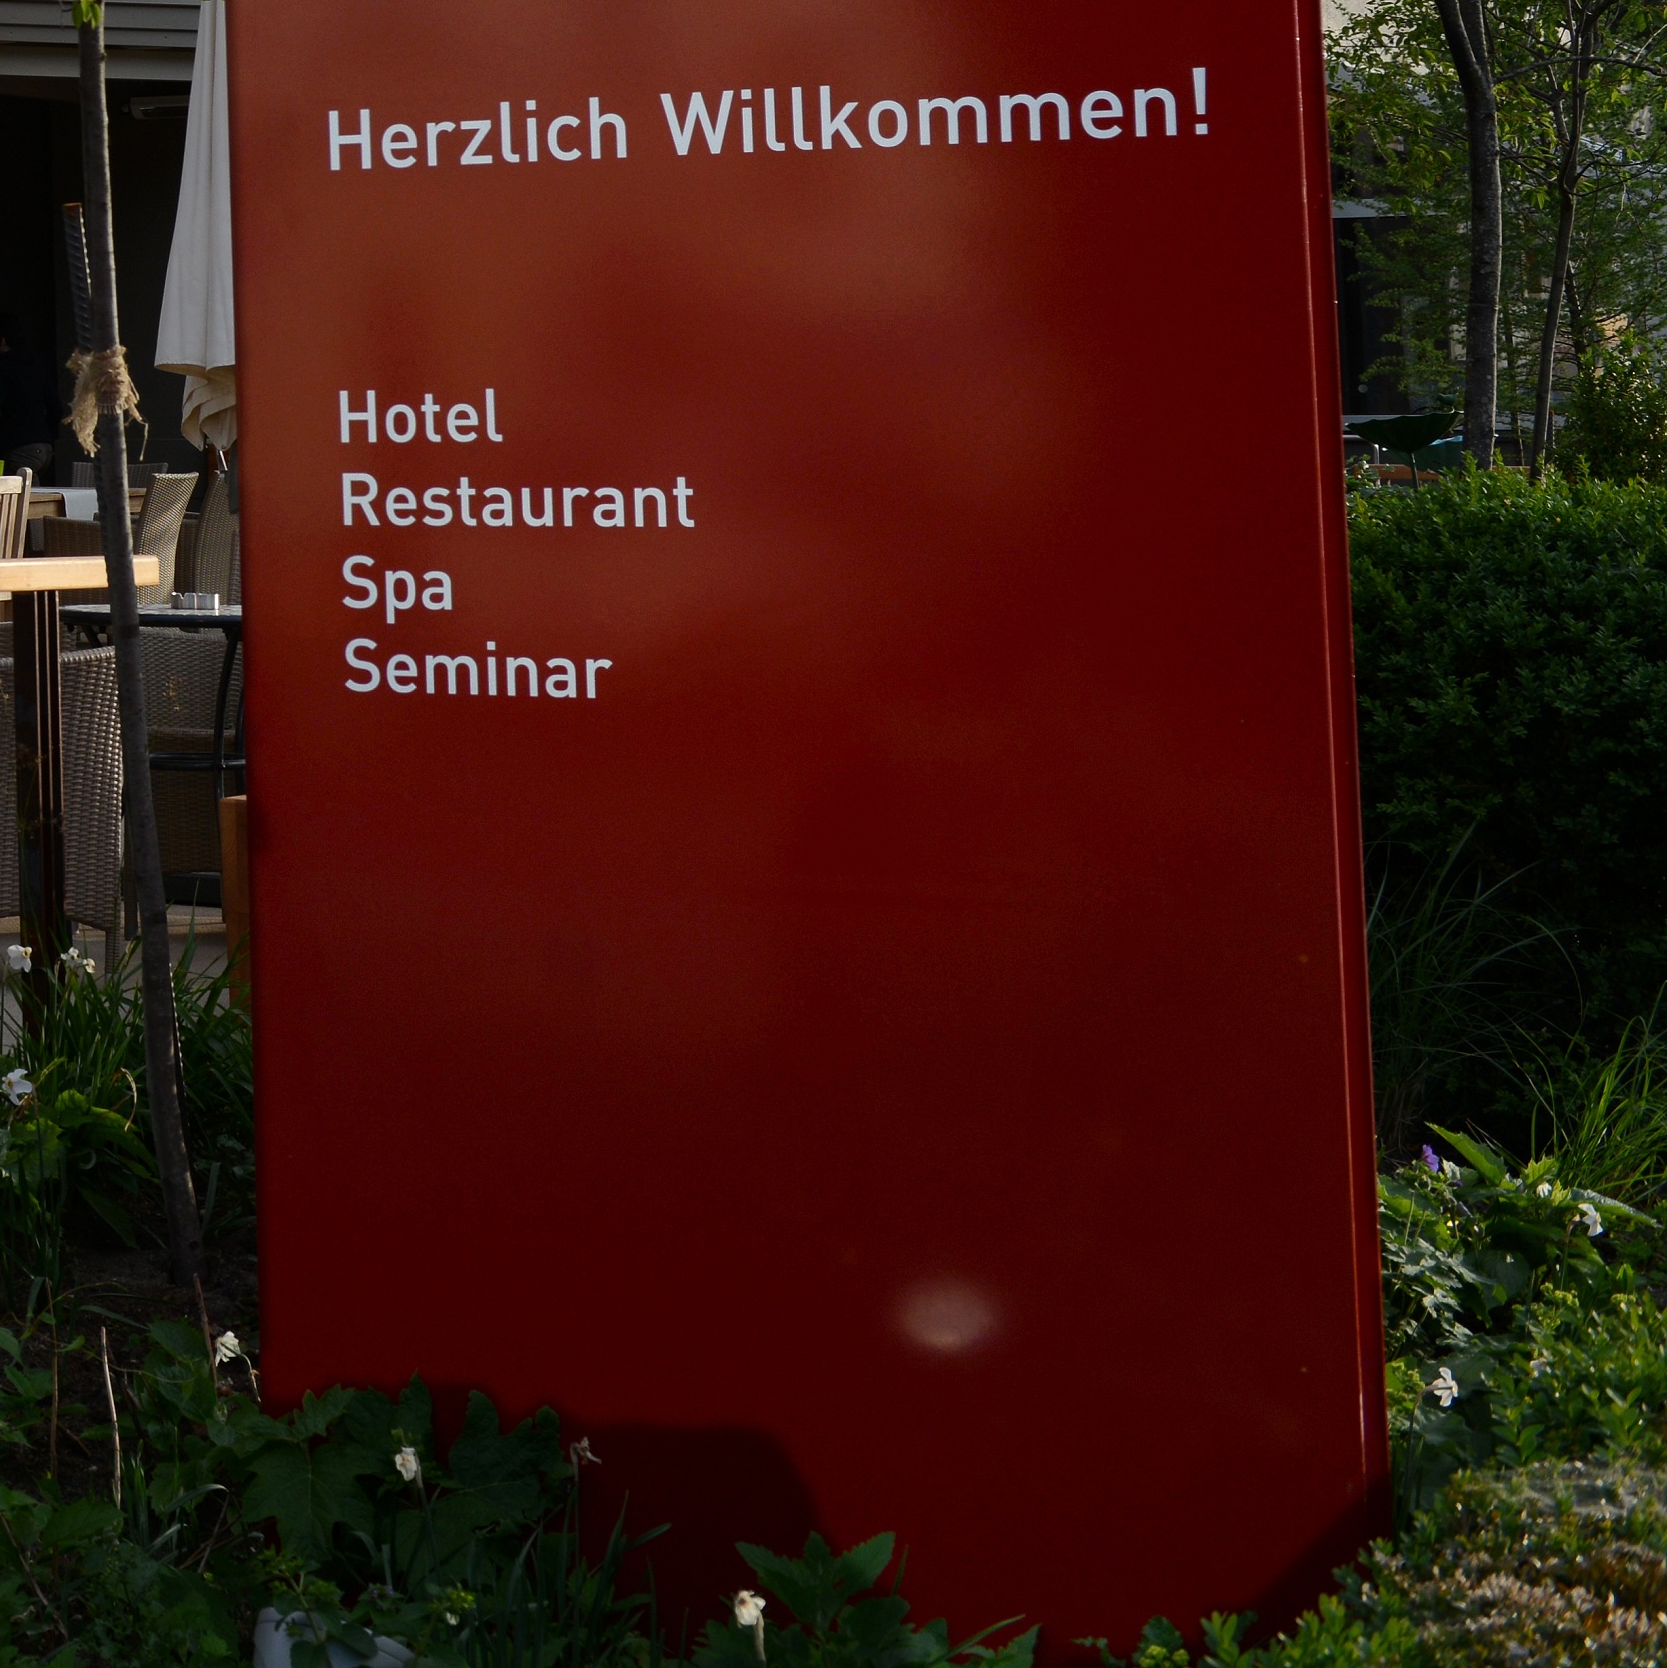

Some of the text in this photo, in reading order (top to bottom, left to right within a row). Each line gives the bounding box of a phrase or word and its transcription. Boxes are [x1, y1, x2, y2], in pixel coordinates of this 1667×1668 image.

[328, 67, 1211, 171] Herzlich Willkommen!
[338, 388, 503, 444] Hotel
[341, 472, 695, 528] Restaurant
[341, 555, 453, 625] Spa
[344, 638, 614, 700] Seminar
